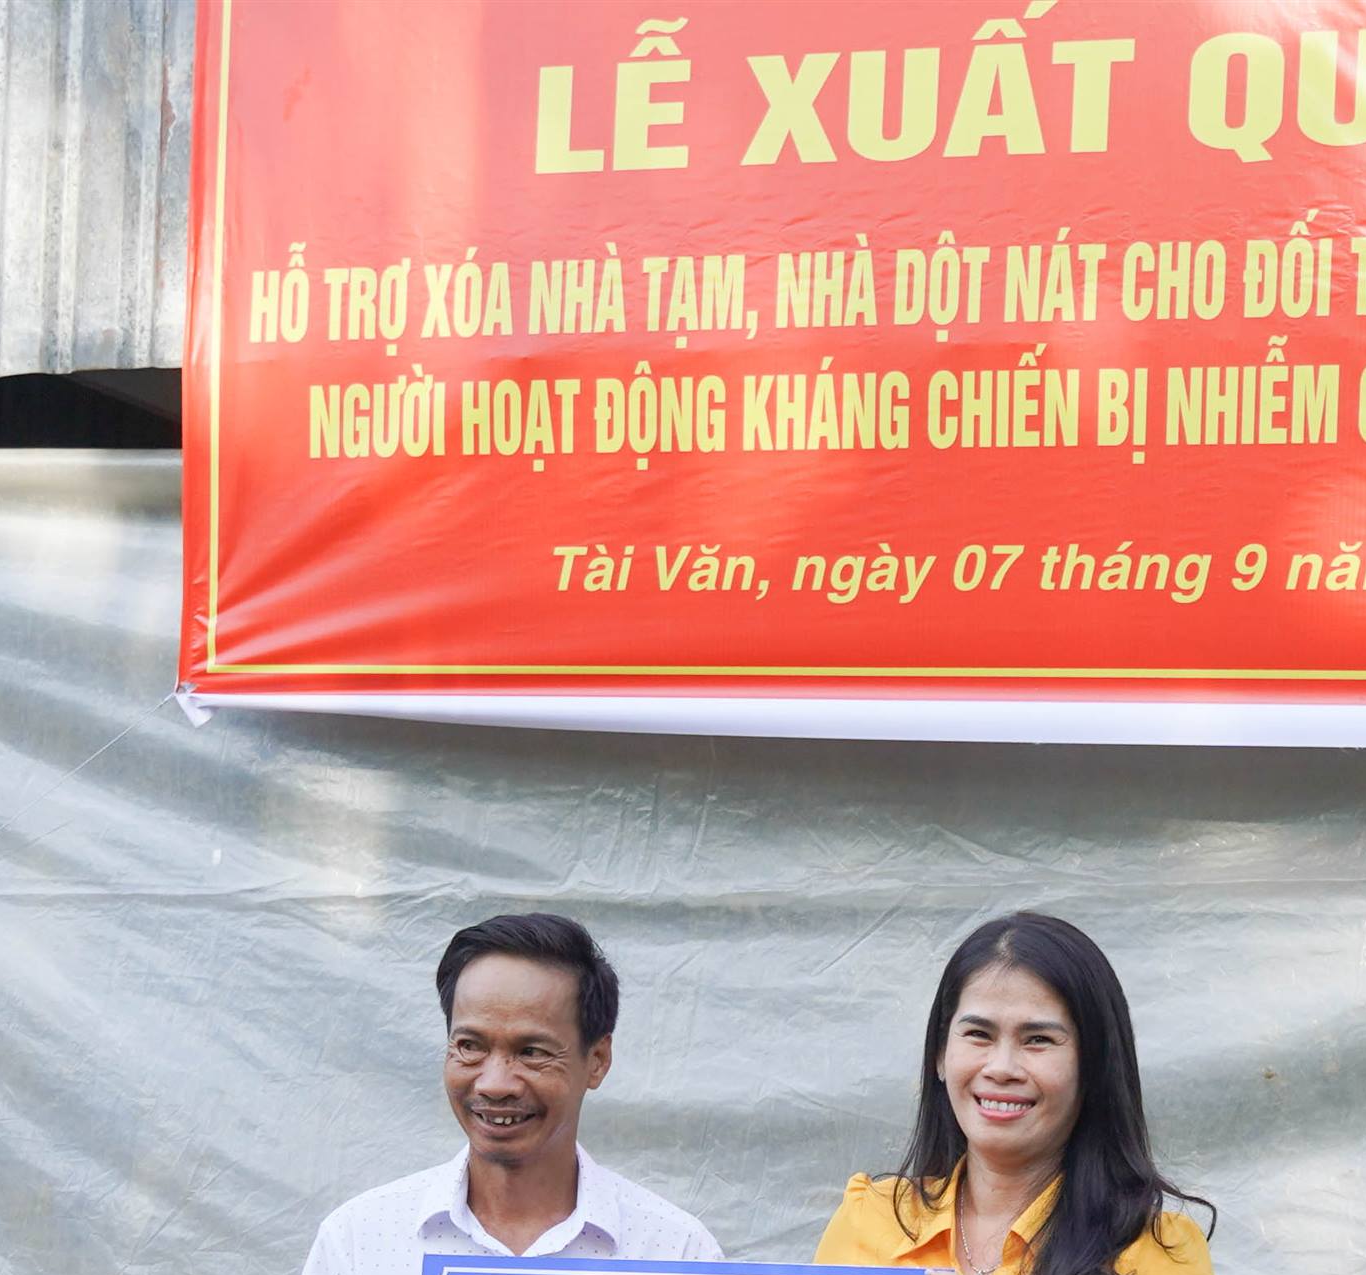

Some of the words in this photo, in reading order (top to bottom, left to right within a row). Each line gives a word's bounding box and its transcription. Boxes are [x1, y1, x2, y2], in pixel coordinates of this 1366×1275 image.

[535, 17, 691, 174] LỄ
[741, 0, 1135, 165] XUẤT
[249, 242, 310, 343] HỖ
[323, 257, 411, 356] TRỢ
[421, 247, 512, 337] XÓA
[528, 242, 626, 333] NHÀ
[642, 255, 758, 349] TẠM,
[775, 233, 877, 328] NHÀ
[894, 230, 990, 342] DỘT
[1004, 227, 1106, 322] NÁT
[1121, 240, 1226, 321] CHO
[1243, 208, 1333, 318] ĐỐI
[309, 364, 446, 459] NGƯỜI
[462, 379, 580, 471] HOẠT
[594, 361, 726, 470] ĐỘNG
[743, 356, 909, 451] KHÁNG
[927, 343, 1080, 449] CHIẾN
[1098, 368, 1147, 464] BỊ
[1166, 336, 1339, 445] NHIỄM
[554, 545, 634, 591] Tài
[656, 545, 768, 599] Văn,
[793, 544, 936, 603] ngày
[954, 545, 1024, 590] 07
[1041, 542, 1211, 603] tháng
[1233, 544, 1267, 590] 9
